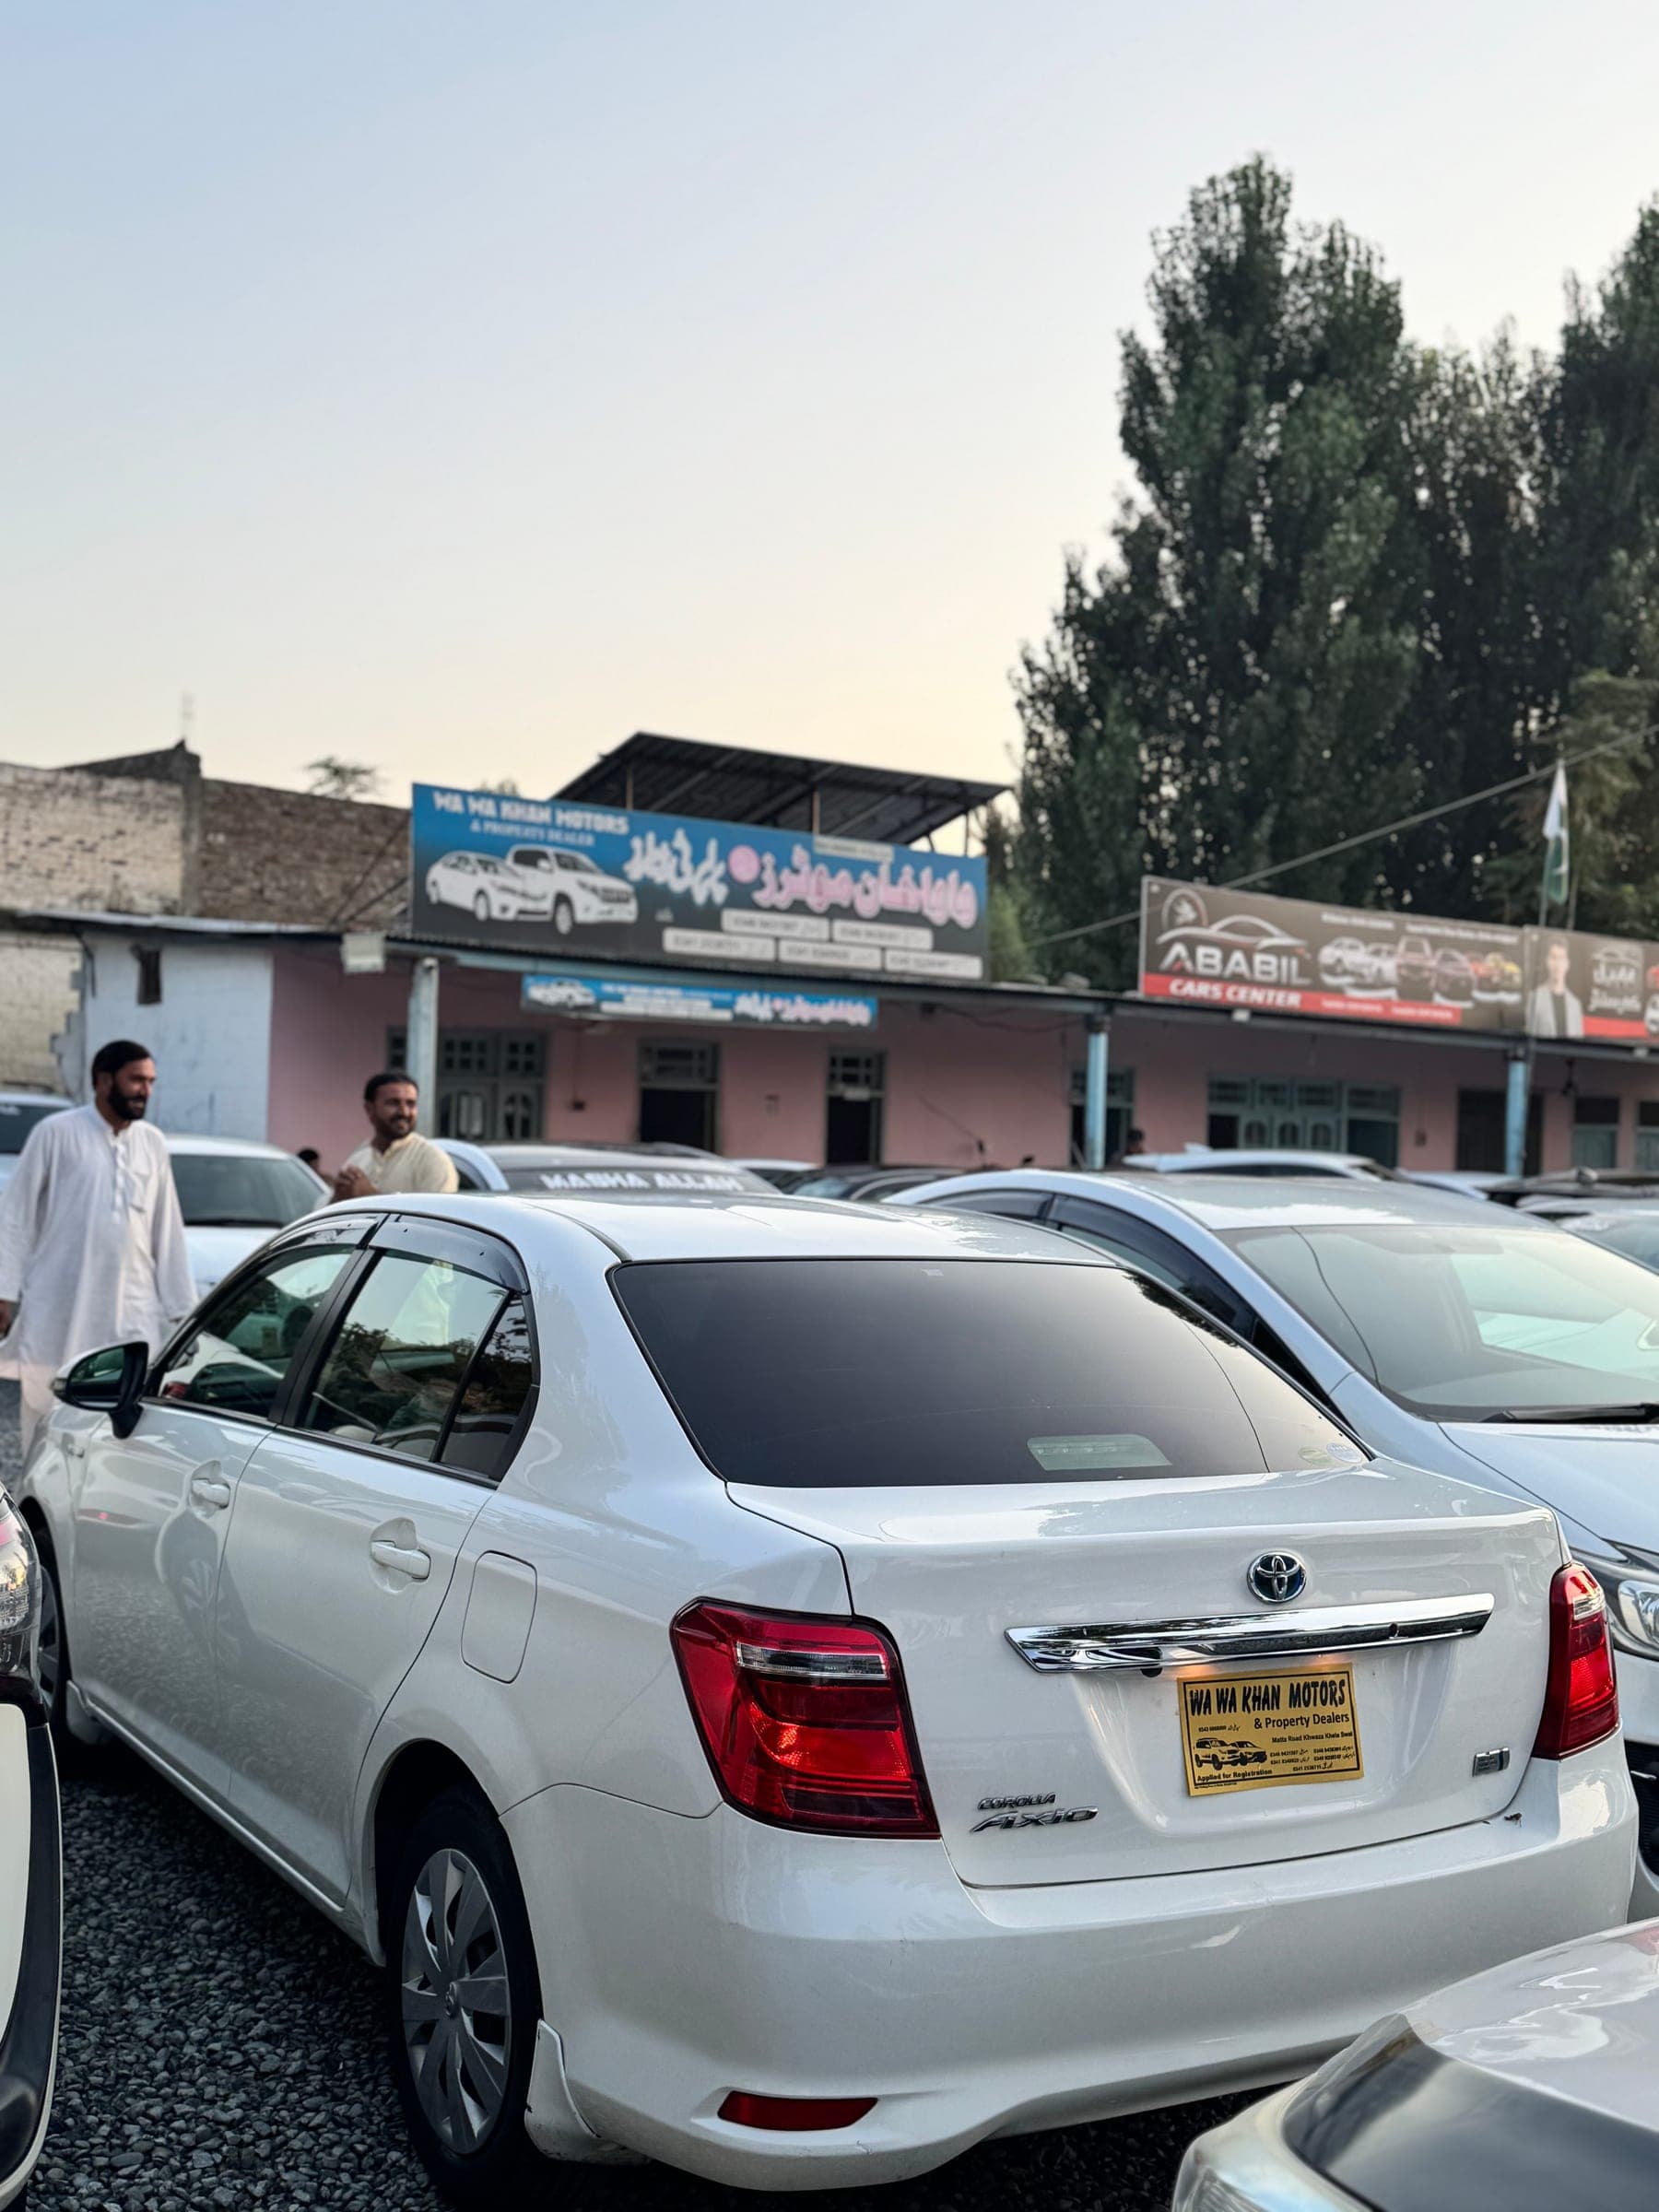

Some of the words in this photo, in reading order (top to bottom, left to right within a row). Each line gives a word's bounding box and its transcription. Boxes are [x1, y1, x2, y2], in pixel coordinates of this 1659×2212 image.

[500, 800, 551, 825] KHAN
[556, 809, 629, 835] MOTORS
[1159, 942, 1312, 986] ABABIL
[1169, 979, 1221, 999] CARS
[1226, 982, 1302, 1008] CENTER
[654, 1172, 744, 1191] ALLAH
[1190, 1688, 1212, 1716] WA
[1216, 1686, 1238, 1714] WA
[1241, 1683, 1280, 1714] KHAN
[1288, 1678, 1346, 1709] MOTORS
[1253, 1717, 1263, 1729] &
[1265, 1713, 1311, 1730] Property
[1312, 1712, 1349, 1726] Dealers
[1197, 1774, 1221, 1783] Applied
[1233, 1769, 1273, 1779] Registration
[977, 1792, 1056, 1810] COROLLA
